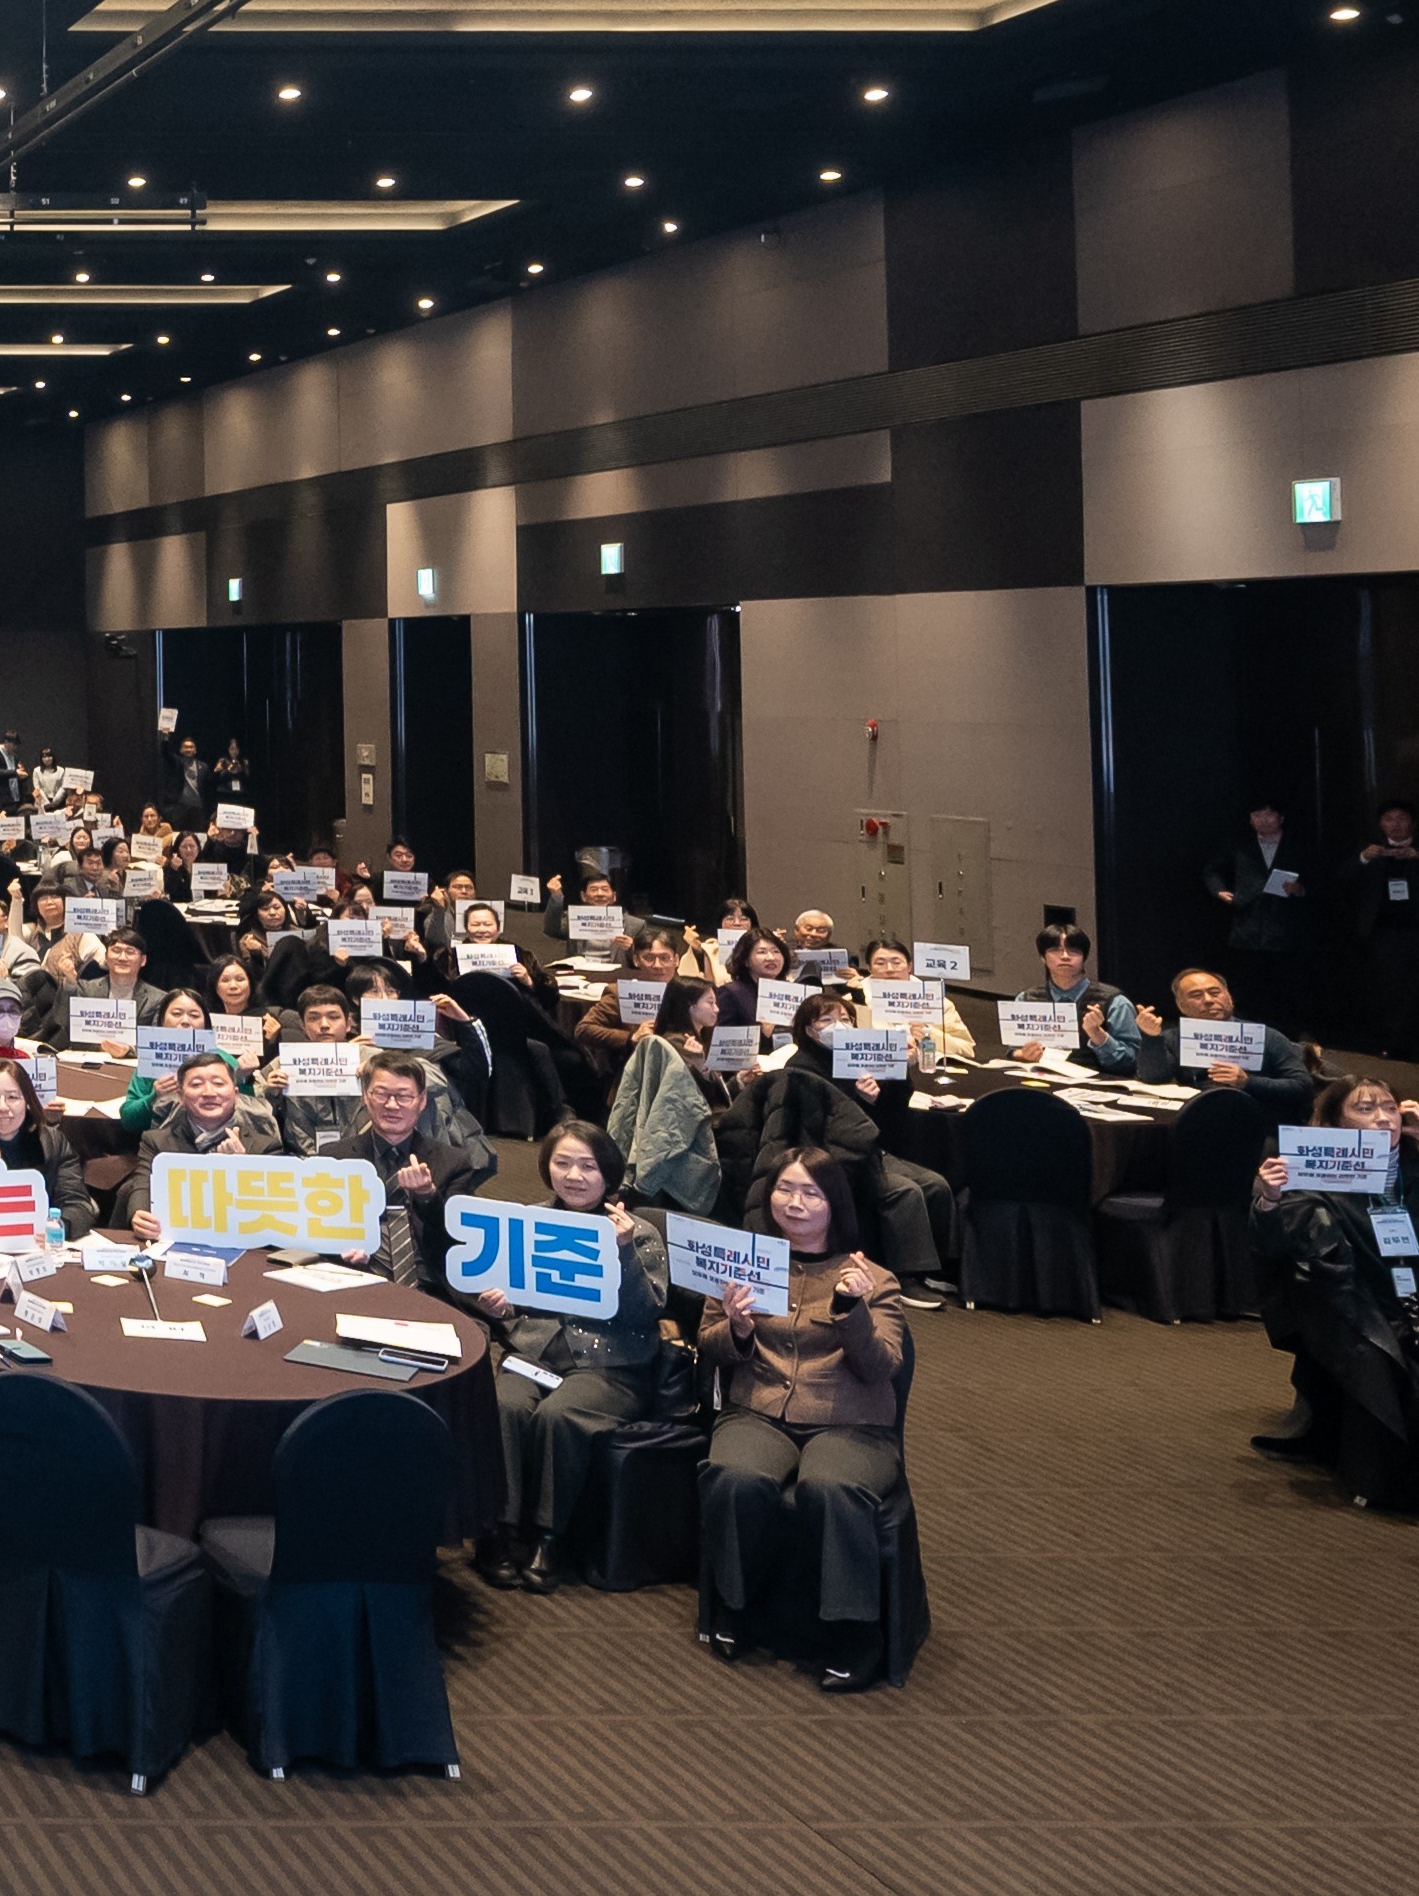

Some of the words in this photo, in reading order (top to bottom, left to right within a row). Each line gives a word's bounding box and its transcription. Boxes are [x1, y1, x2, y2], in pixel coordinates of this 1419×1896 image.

[925, 958, 947, 971] 교육
[950, 960, 958, 971] 2
[1193, 1033, 1253, 1044] 화성특례시민
[1297, 1146, 1374, 1158] 화성특례시민
[1305, 1159, 1365, 1171] 복지기준선
[167, 1168, 371, 1240] 따뜻한
[460, 1211, 603, 1303] 기준
[687, 1240, 770, 1270] 화성특례시민
[696, 1256, 761, 1281] 복지기준선
